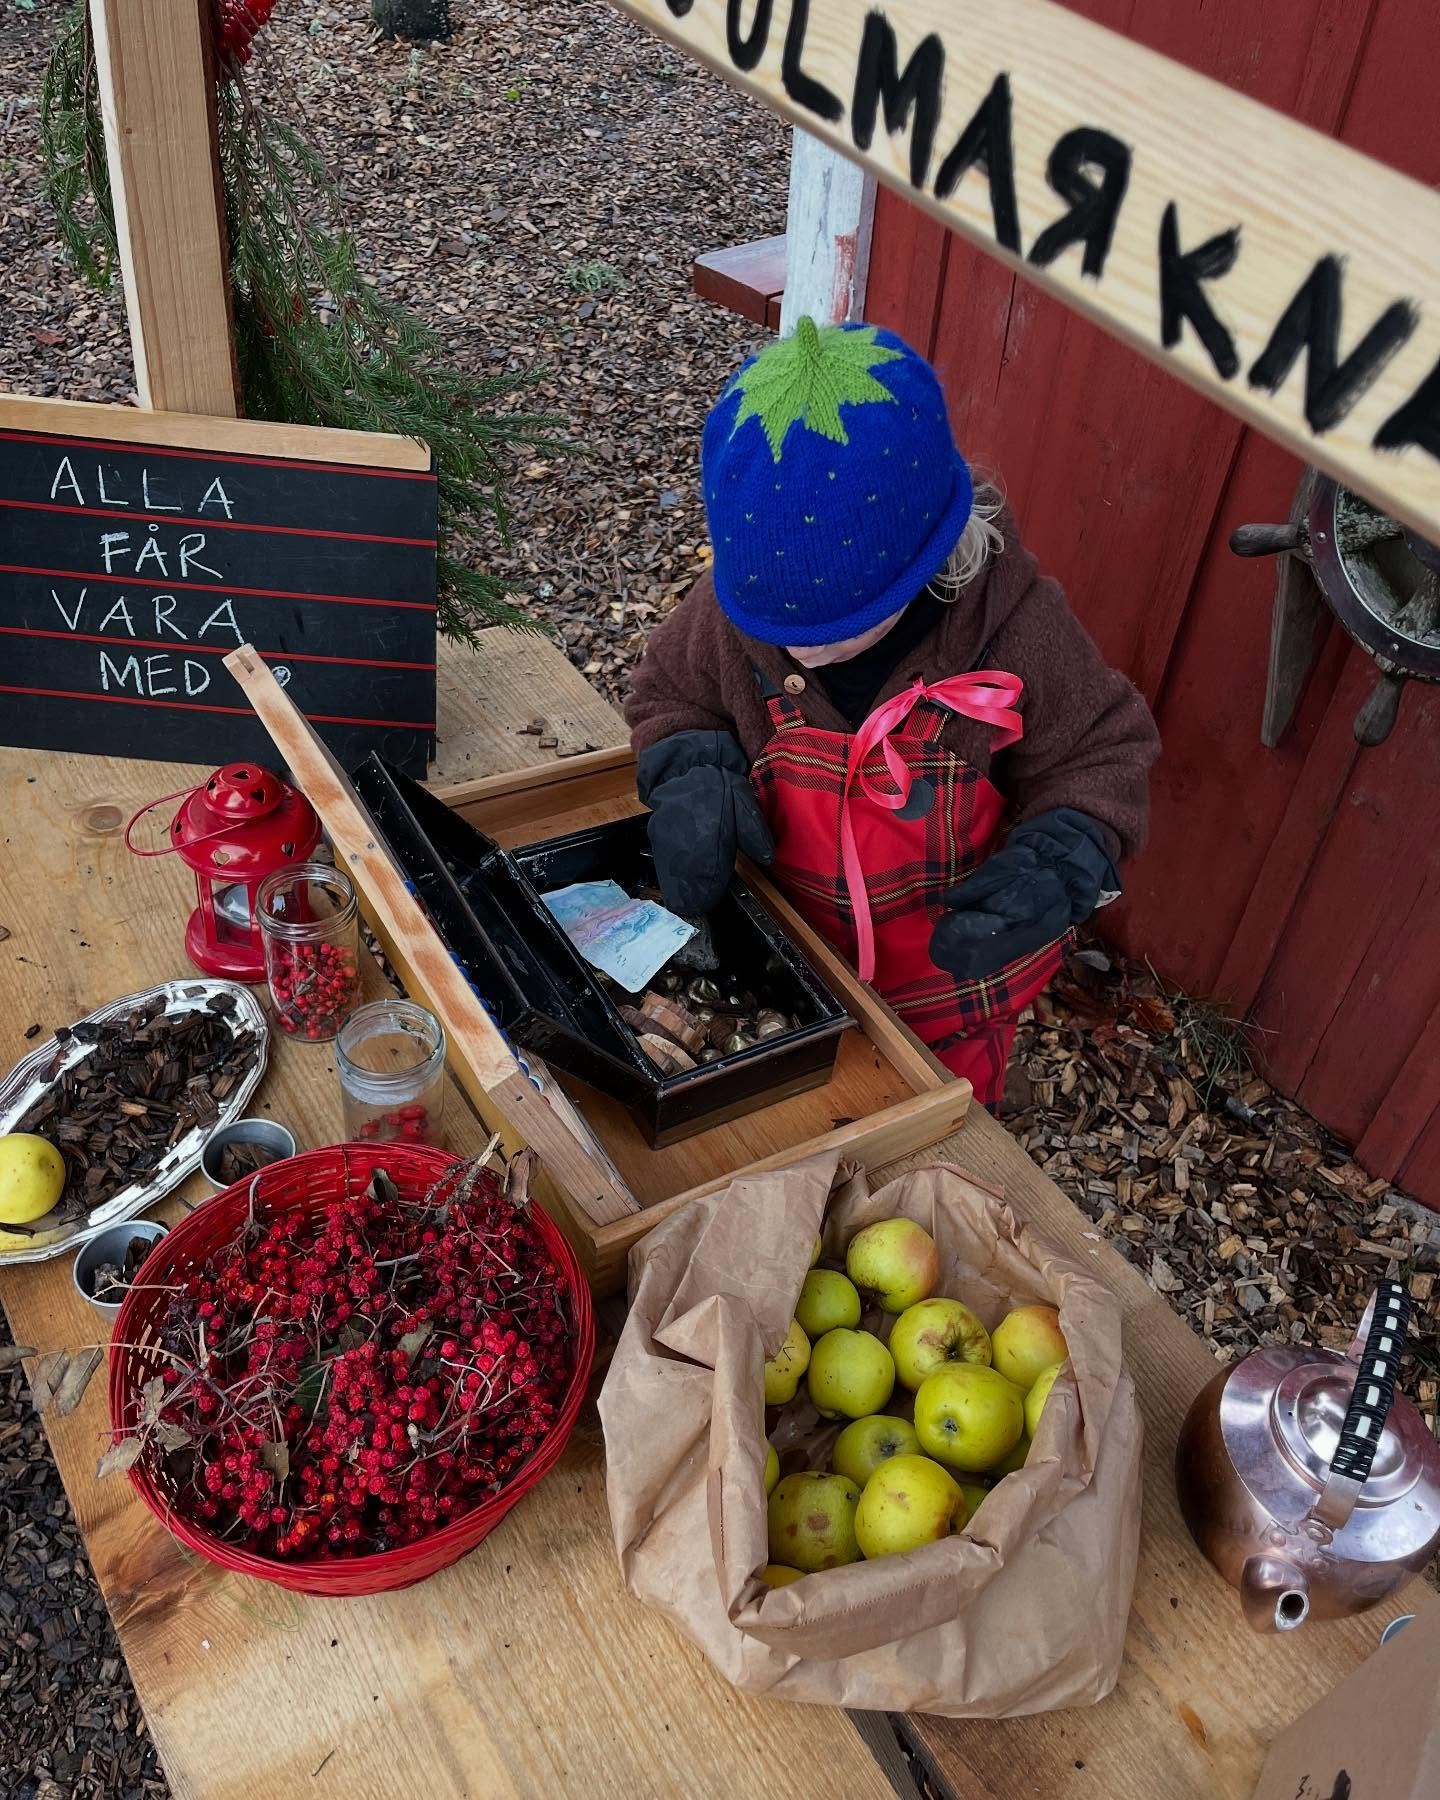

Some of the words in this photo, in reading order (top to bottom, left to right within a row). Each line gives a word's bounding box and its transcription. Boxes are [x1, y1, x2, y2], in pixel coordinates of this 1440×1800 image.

[50, 456, 235, 520] ALLA
[99, 523, 224, 579] FÅR
[51, 587, 246, 645] VARA
[99, 650, 211, 697] MED
